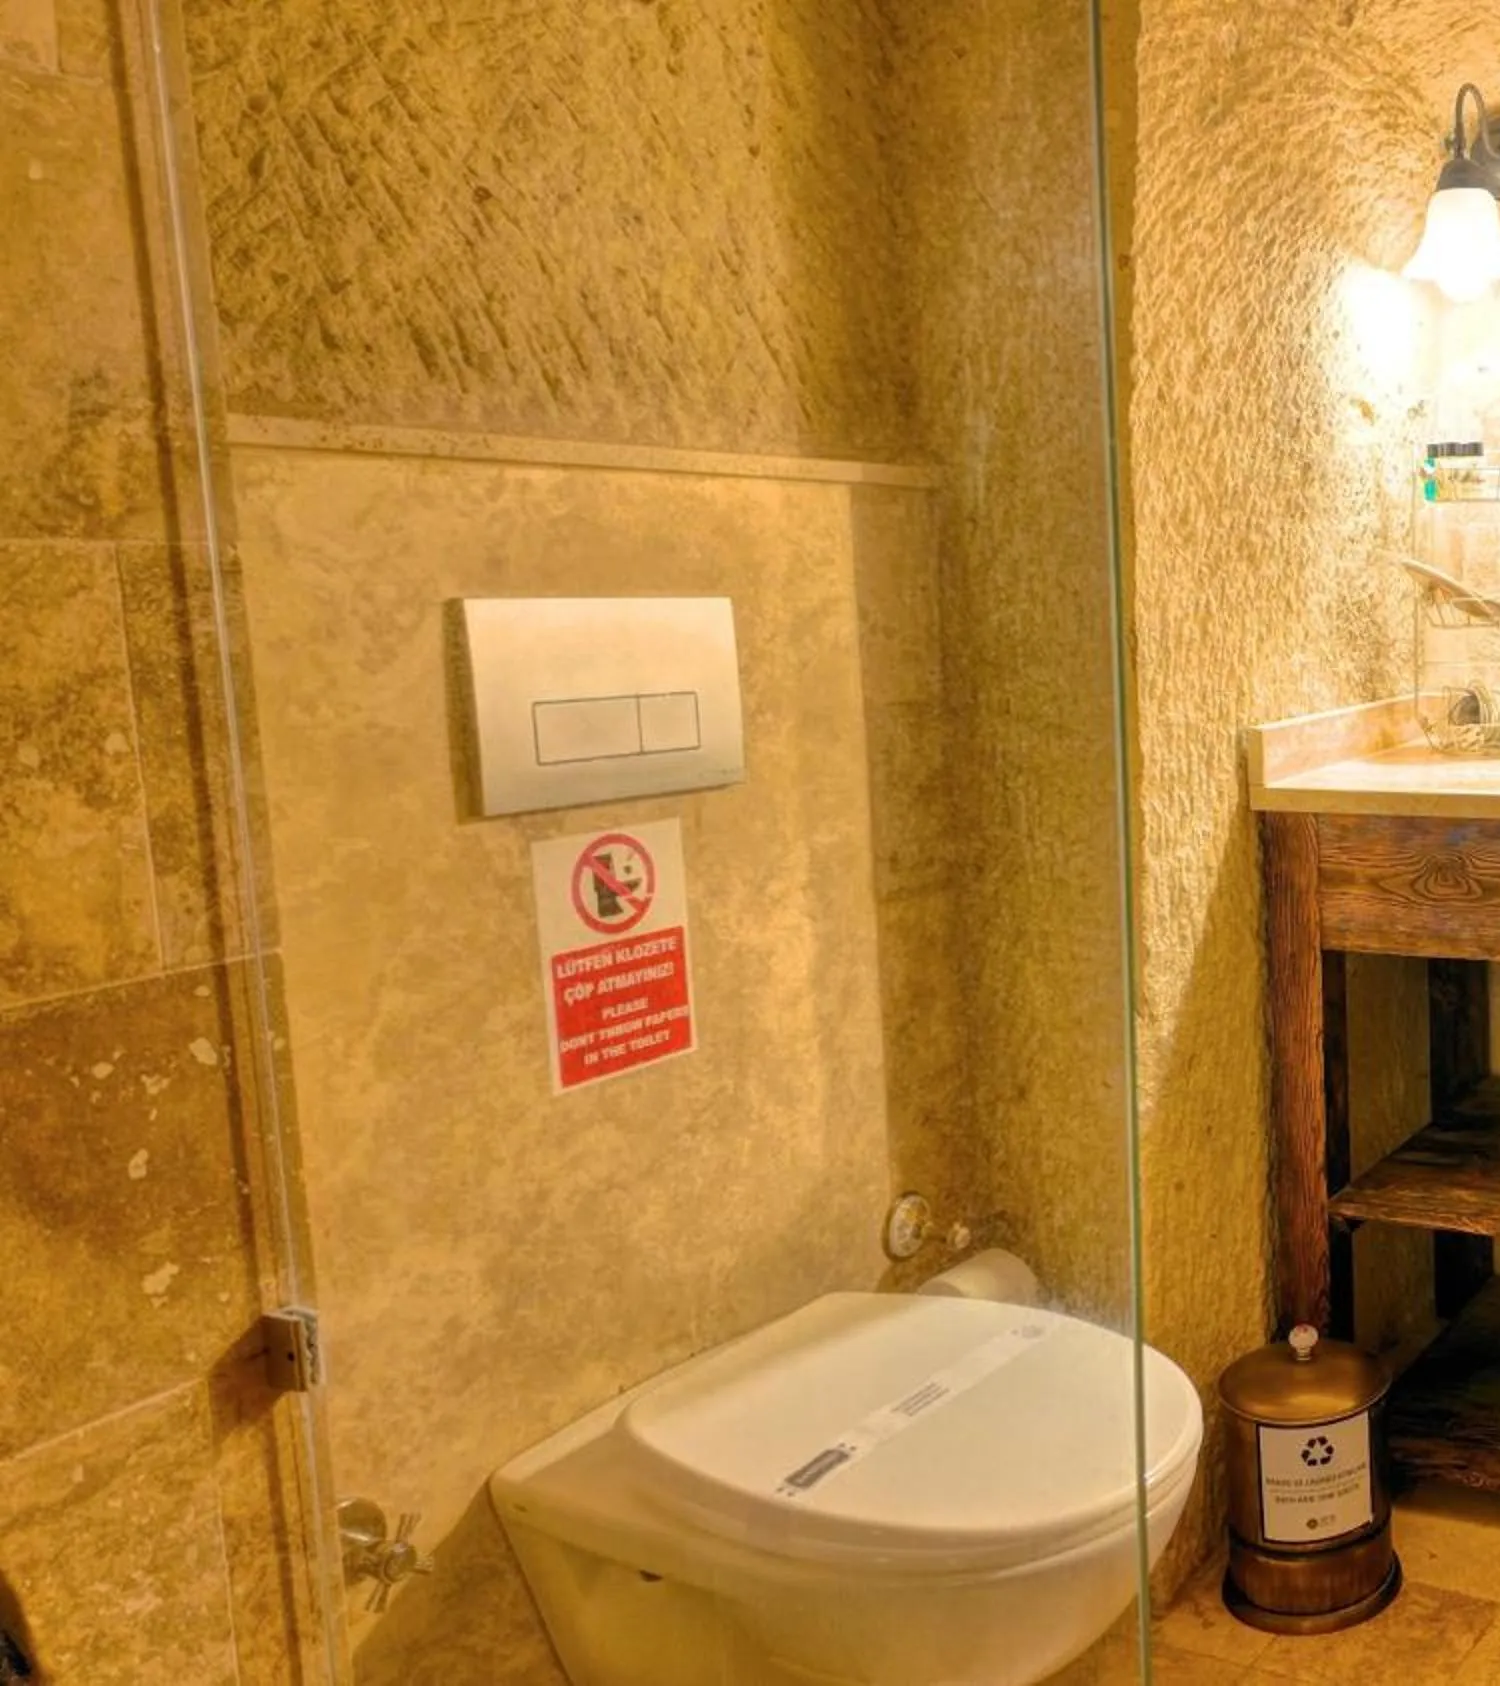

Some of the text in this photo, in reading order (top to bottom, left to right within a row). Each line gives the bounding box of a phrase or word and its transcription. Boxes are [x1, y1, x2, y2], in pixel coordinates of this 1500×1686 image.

[556, 936, 677, 979] LÜTFEN KLOZETE
[563, 981, 595, 1007] ÇÖP
[602, 997, 648, 1020] PLEASE
[584, 1051, 600, 1066] IN
[601, 1042, 627, 1060] THE
